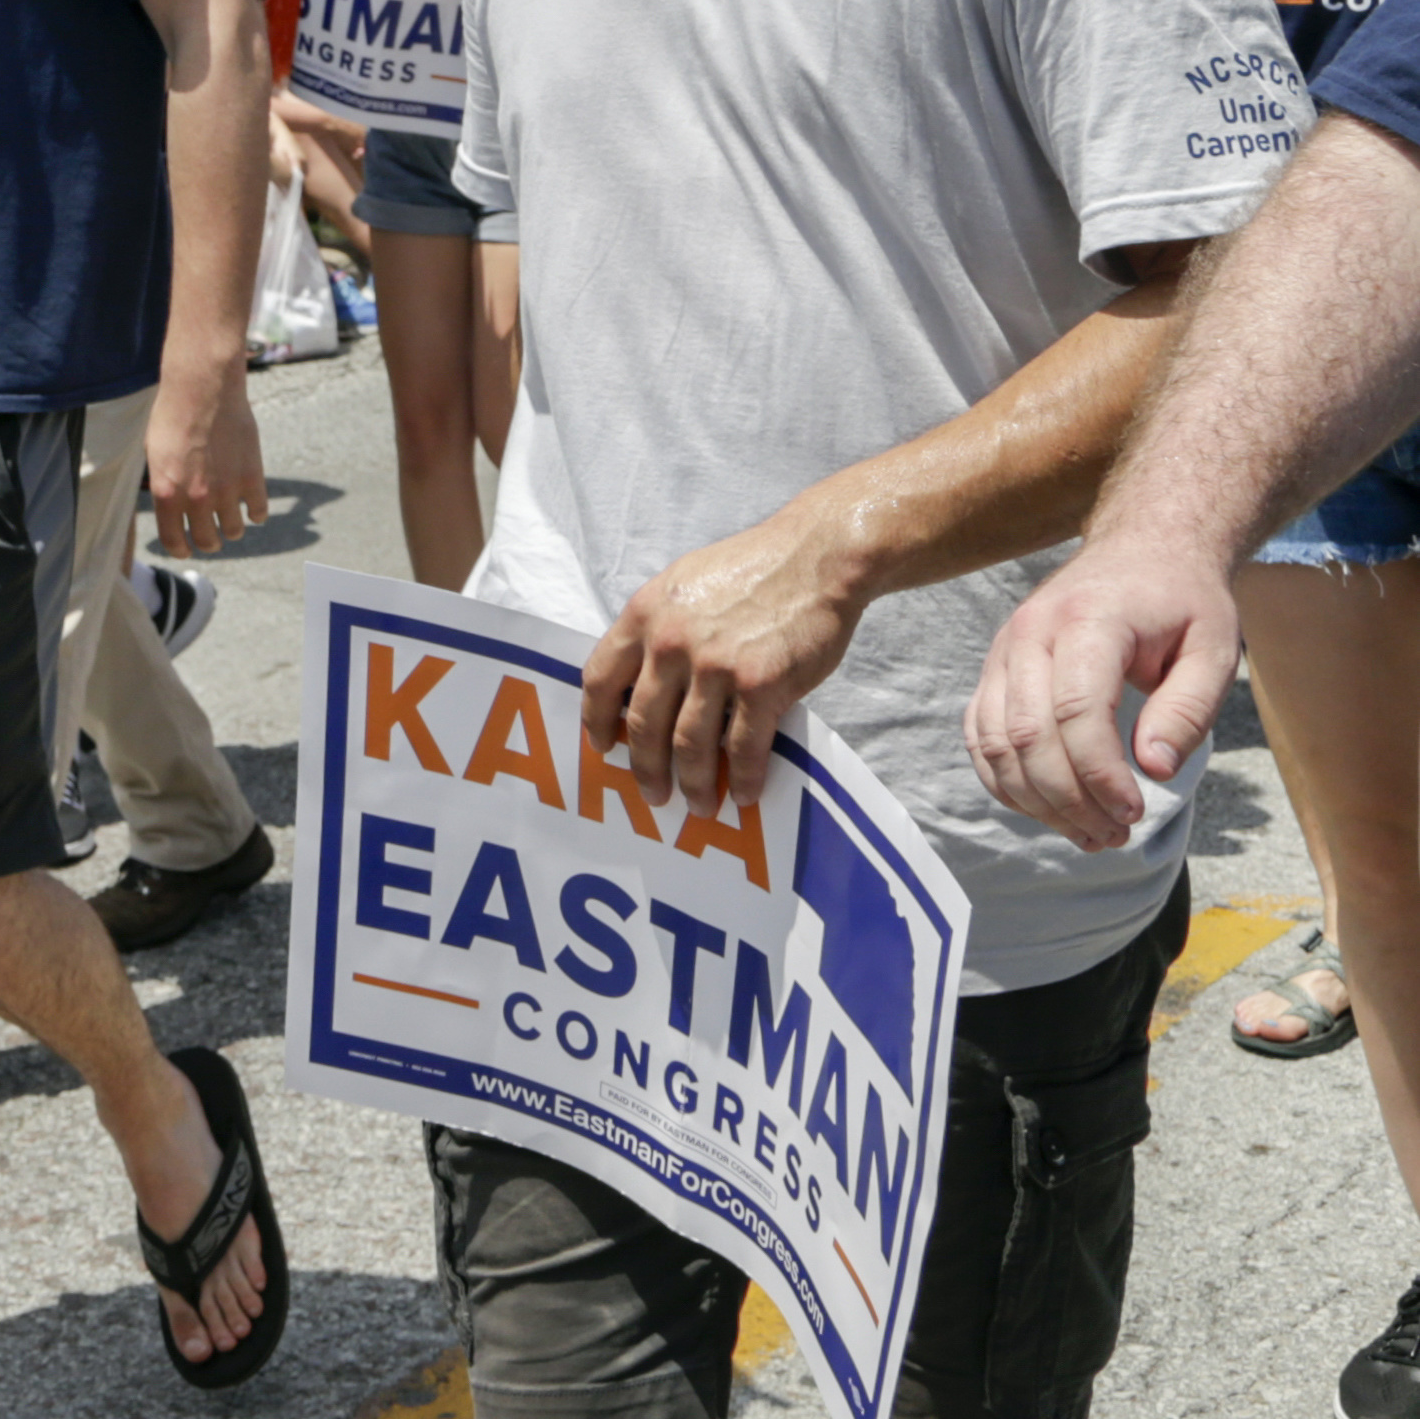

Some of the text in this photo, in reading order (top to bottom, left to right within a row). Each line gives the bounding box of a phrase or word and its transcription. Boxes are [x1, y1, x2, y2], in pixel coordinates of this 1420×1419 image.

[363, 642, 771, 894] KARA
[355, 812, 910, 1266] EASTMAN
[502, 991, 824, 1234] CONGRESS
[607, 1088, 773, 1201] PAID FOR BY EASTMAN FOR CONGRESS
[471, 1071, 826, 1336] www.EastmanForCongress.com
